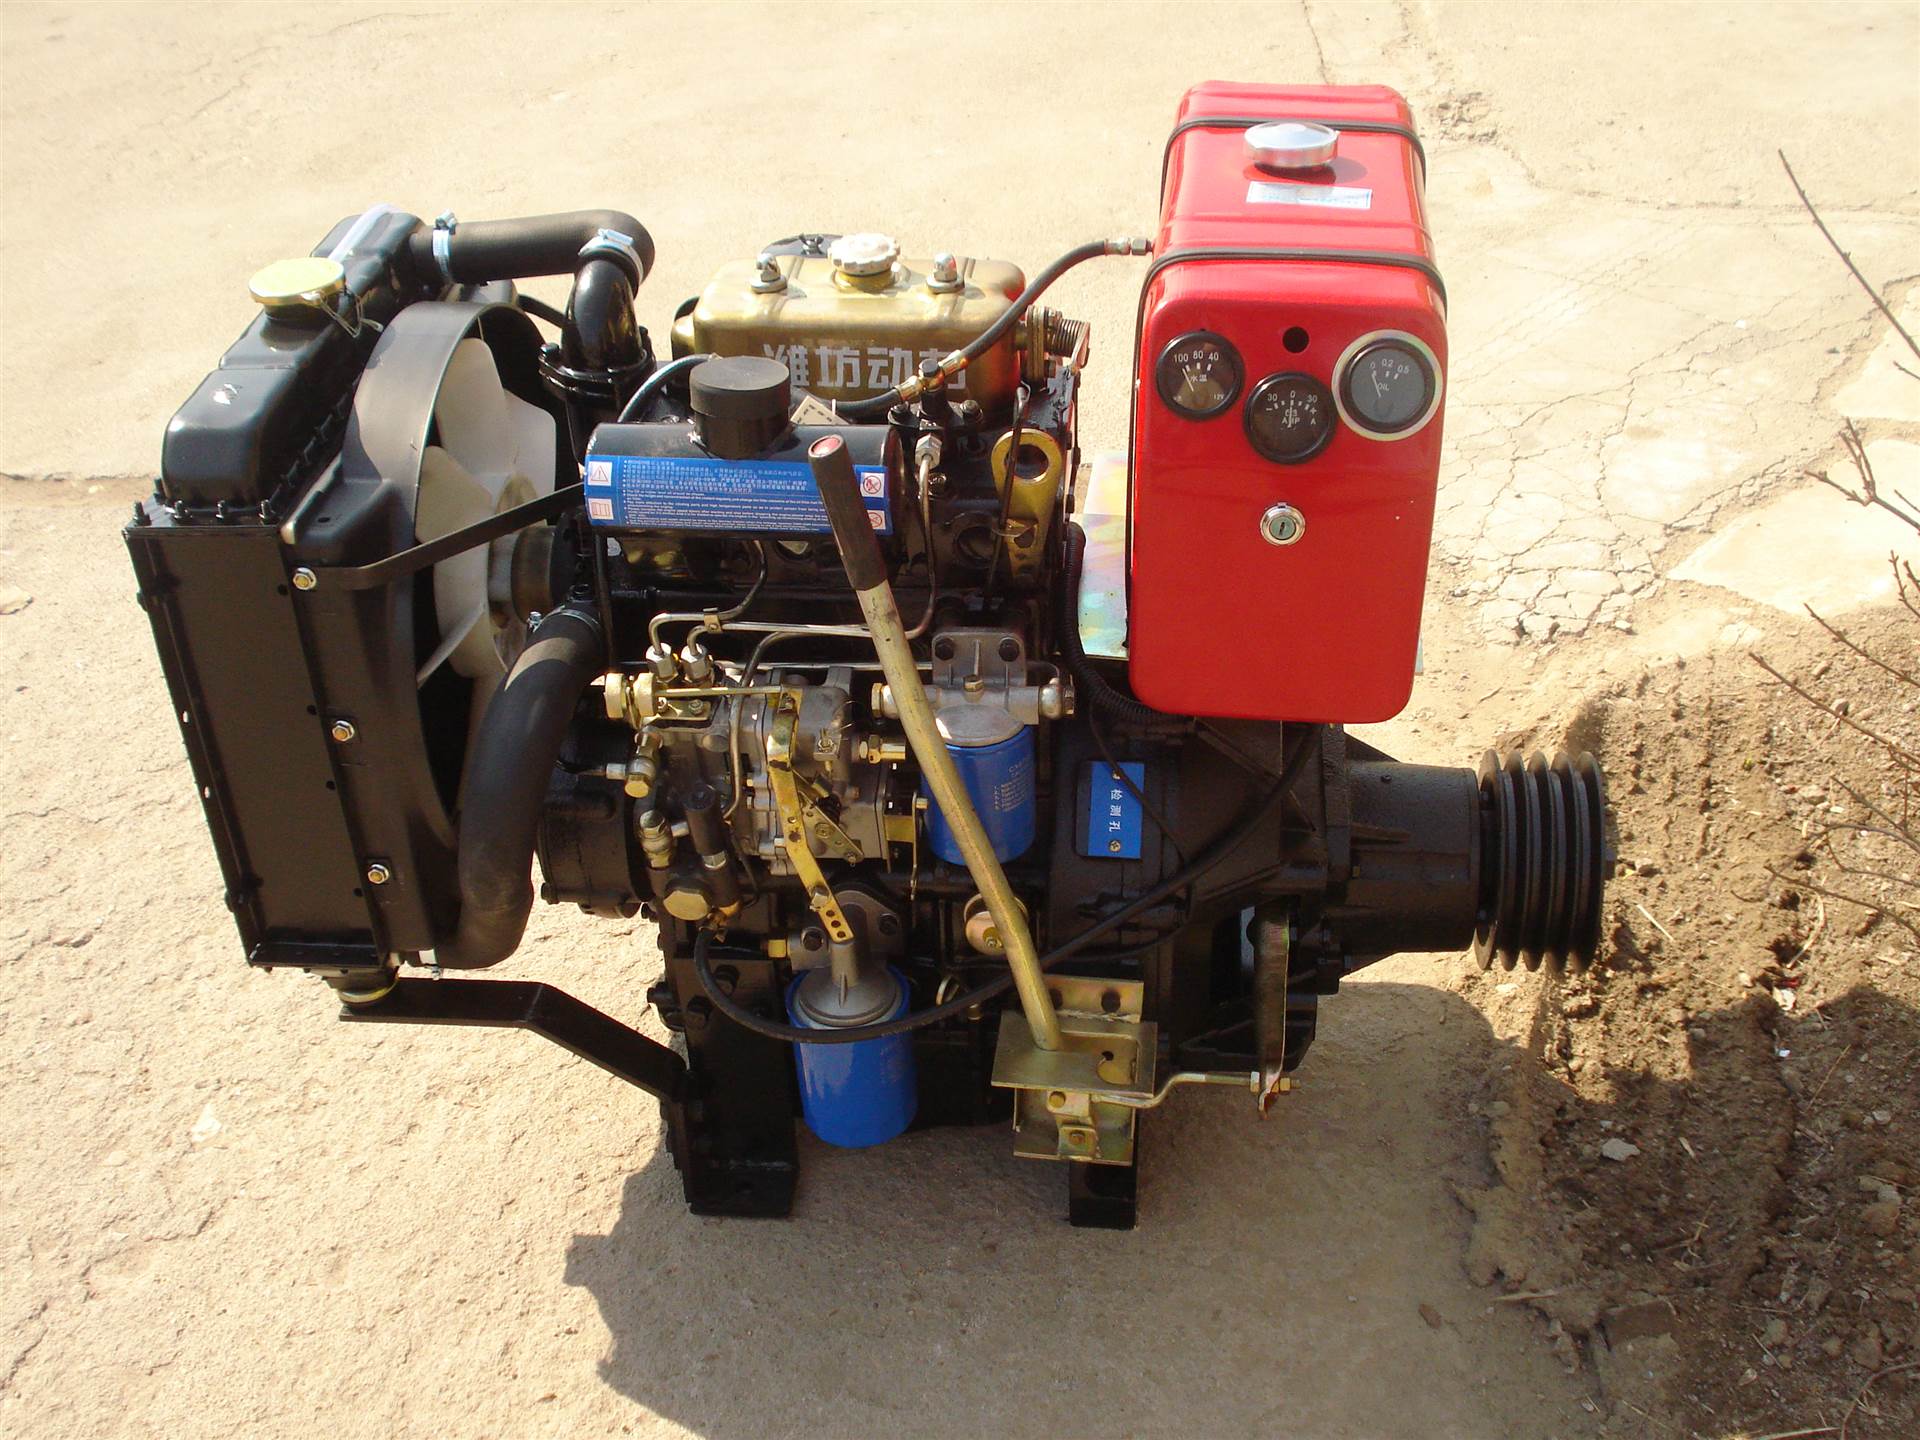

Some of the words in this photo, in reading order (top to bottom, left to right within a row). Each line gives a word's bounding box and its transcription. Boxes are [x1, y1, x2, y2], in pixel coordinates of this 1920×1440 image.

[1174, 353, 1188, 363] 100
[1193, 350, 1203, 359] 80
[1208, 352, 1219, 361] 40
[1267, 393, 1278, 402] 30
[1290, 390, 1296, 398] 0
[1307, 394, 1318, 403] 30
